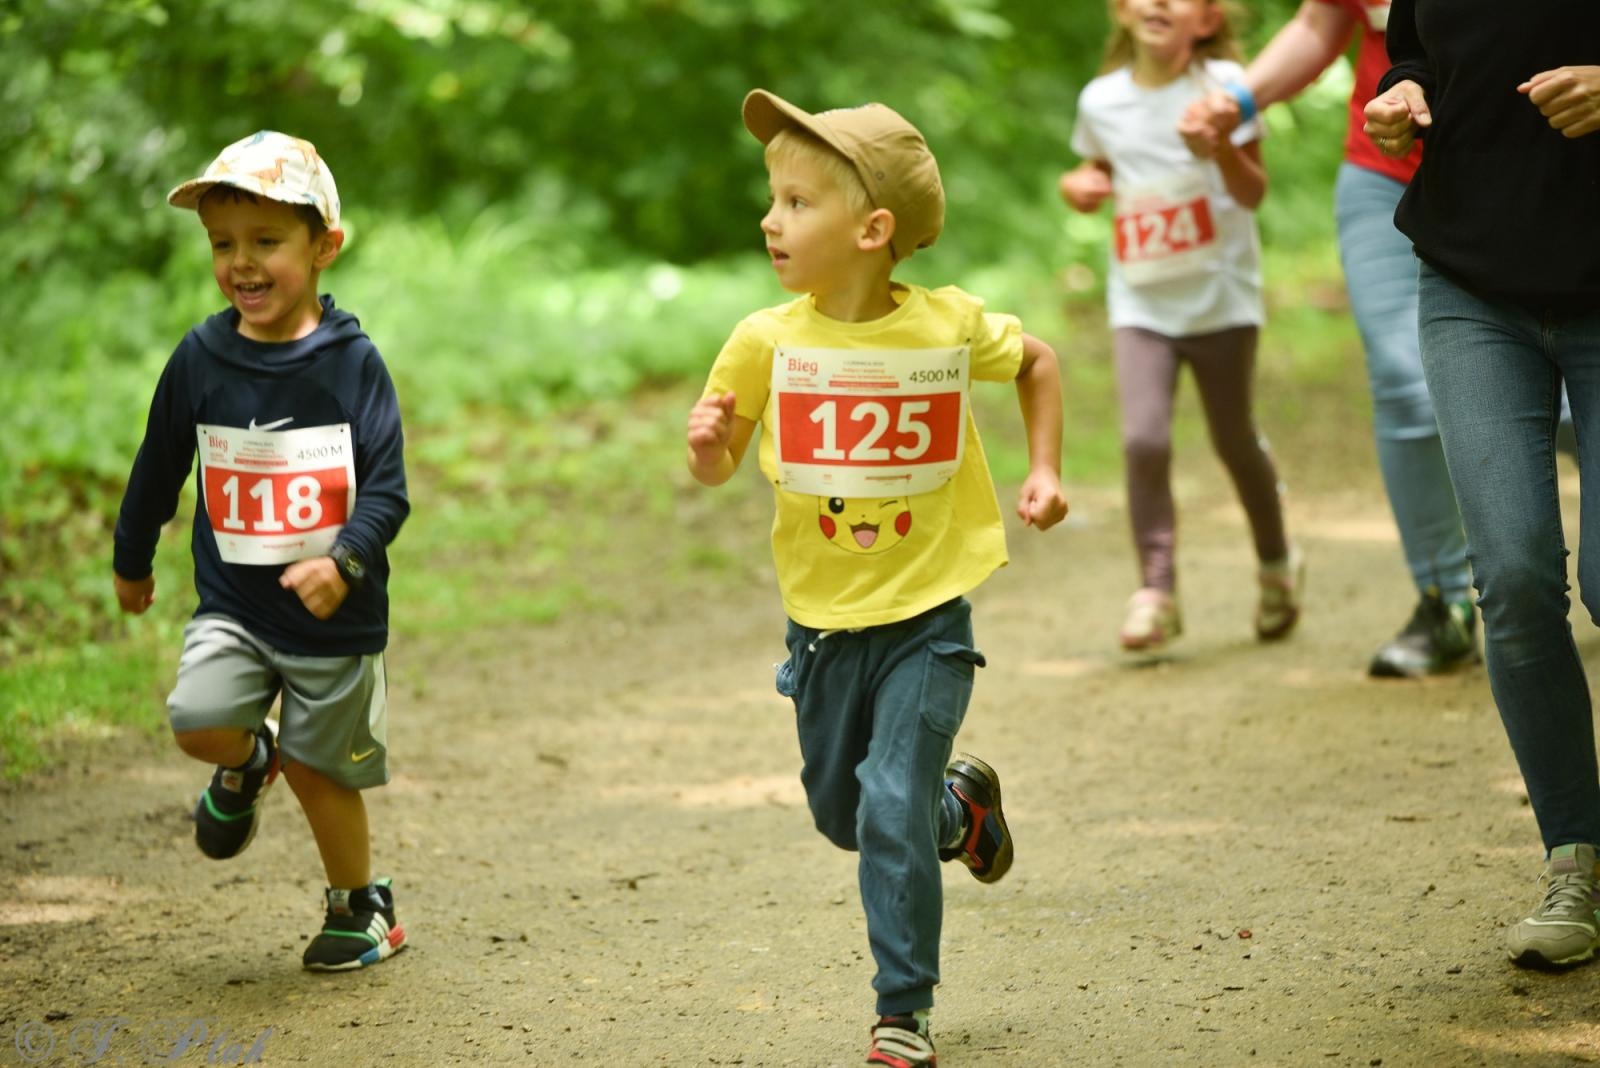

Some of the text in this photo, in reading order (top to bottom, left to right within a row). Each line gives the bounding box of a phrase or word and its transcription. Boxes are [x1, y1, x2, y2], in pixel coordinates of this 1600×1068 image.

[1120, 207, 1202, 259] 124
[787, 358, 818, 376] Bieg
[909, 370, 944, 385] 4500
[947, 368, 960, 381] M
[809, 400, 932, 462] 125
[208, 435, 229, 452] Bieg
[297, 447, 328, 461] 4500
[330, 444, 343, 457] M
[222, 475, 323, 532] 118
